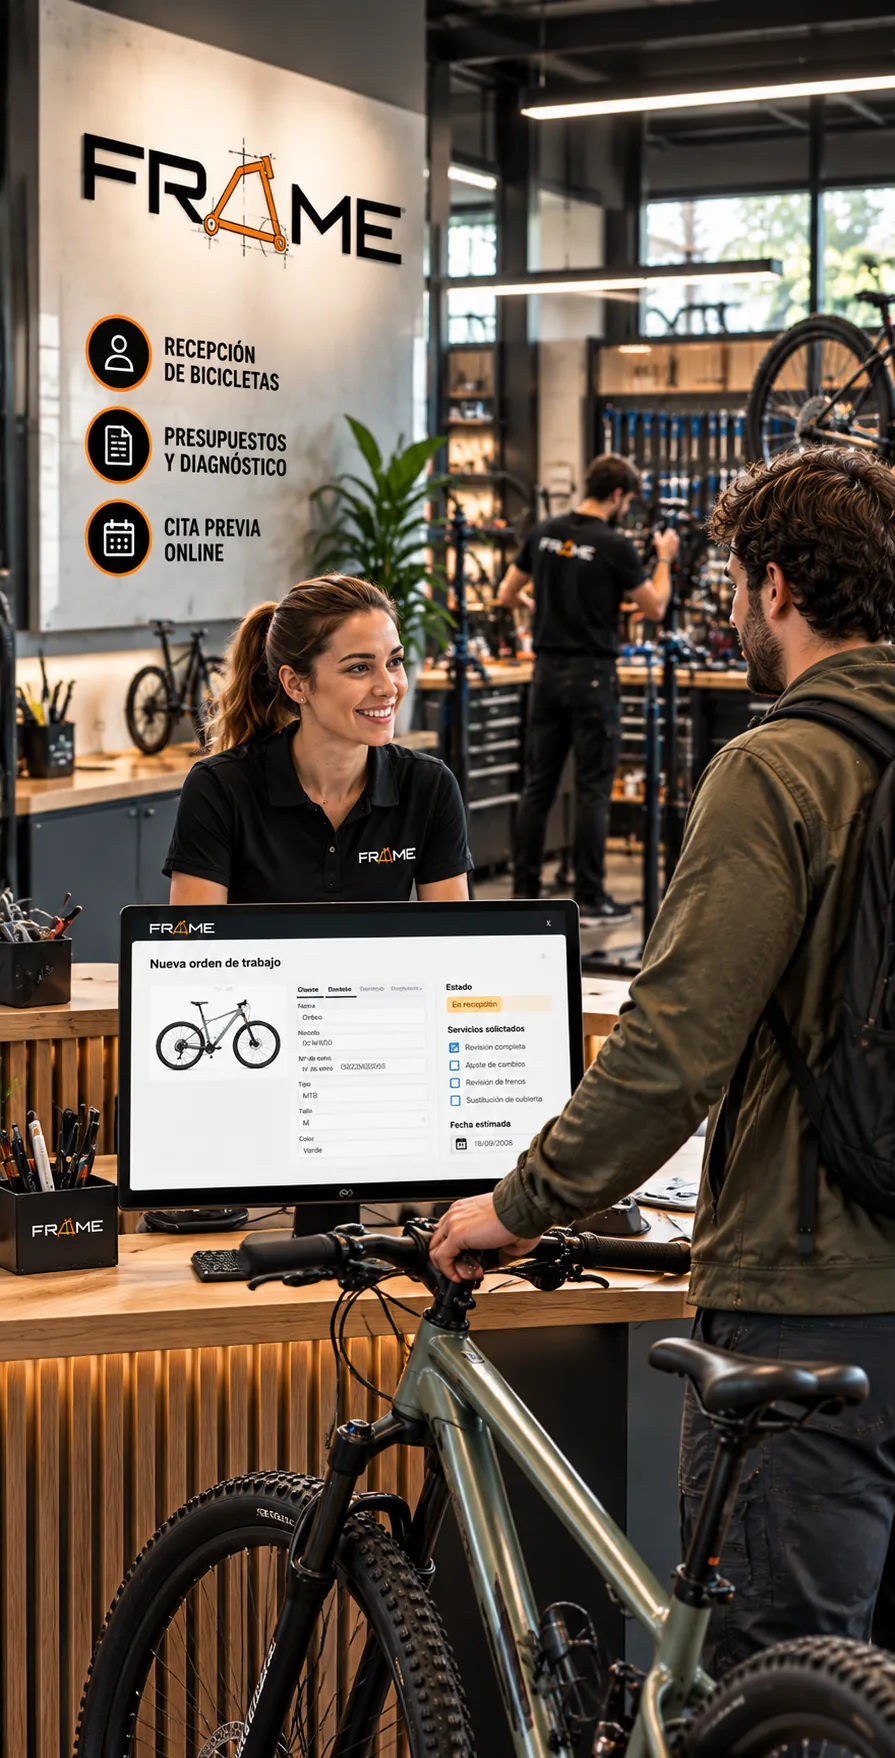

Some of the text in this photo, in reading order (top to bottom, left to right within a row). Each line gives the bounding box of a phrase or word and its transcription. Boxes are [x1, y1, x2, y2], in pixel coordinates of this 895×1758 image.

[82, 132, 403, 266] FRAME
[164, 336, 256, 364] RECEPCIÓN
[164, 362, 280, 391] DE BICICLETAS
[164, 426, 287, 452] PRESUPUESTOS
[164, 451, 287, 478] Y DIAGNÓSTICO
[164, 517, 261, 537] CITA PREVIA
[164, 542, 224, 562] ONLINE
[358, 846, 417, 865] FRAME
[149, 920, 215, 935] FRAME
[150, 957, 282, 970] Nueva orden de trabajo
[446, 983, 473, 991] Estado
[447, 1026, 484, 1034] Servicios
[494, 1043, 526, 1052] completa
[497, 1060, 526, 1068] cambios
[505, 1095, 515, 1103] de
[450, 1120, 511, 1129] Fecha estimada
[31, 1217, 104, 1238] FRAME
